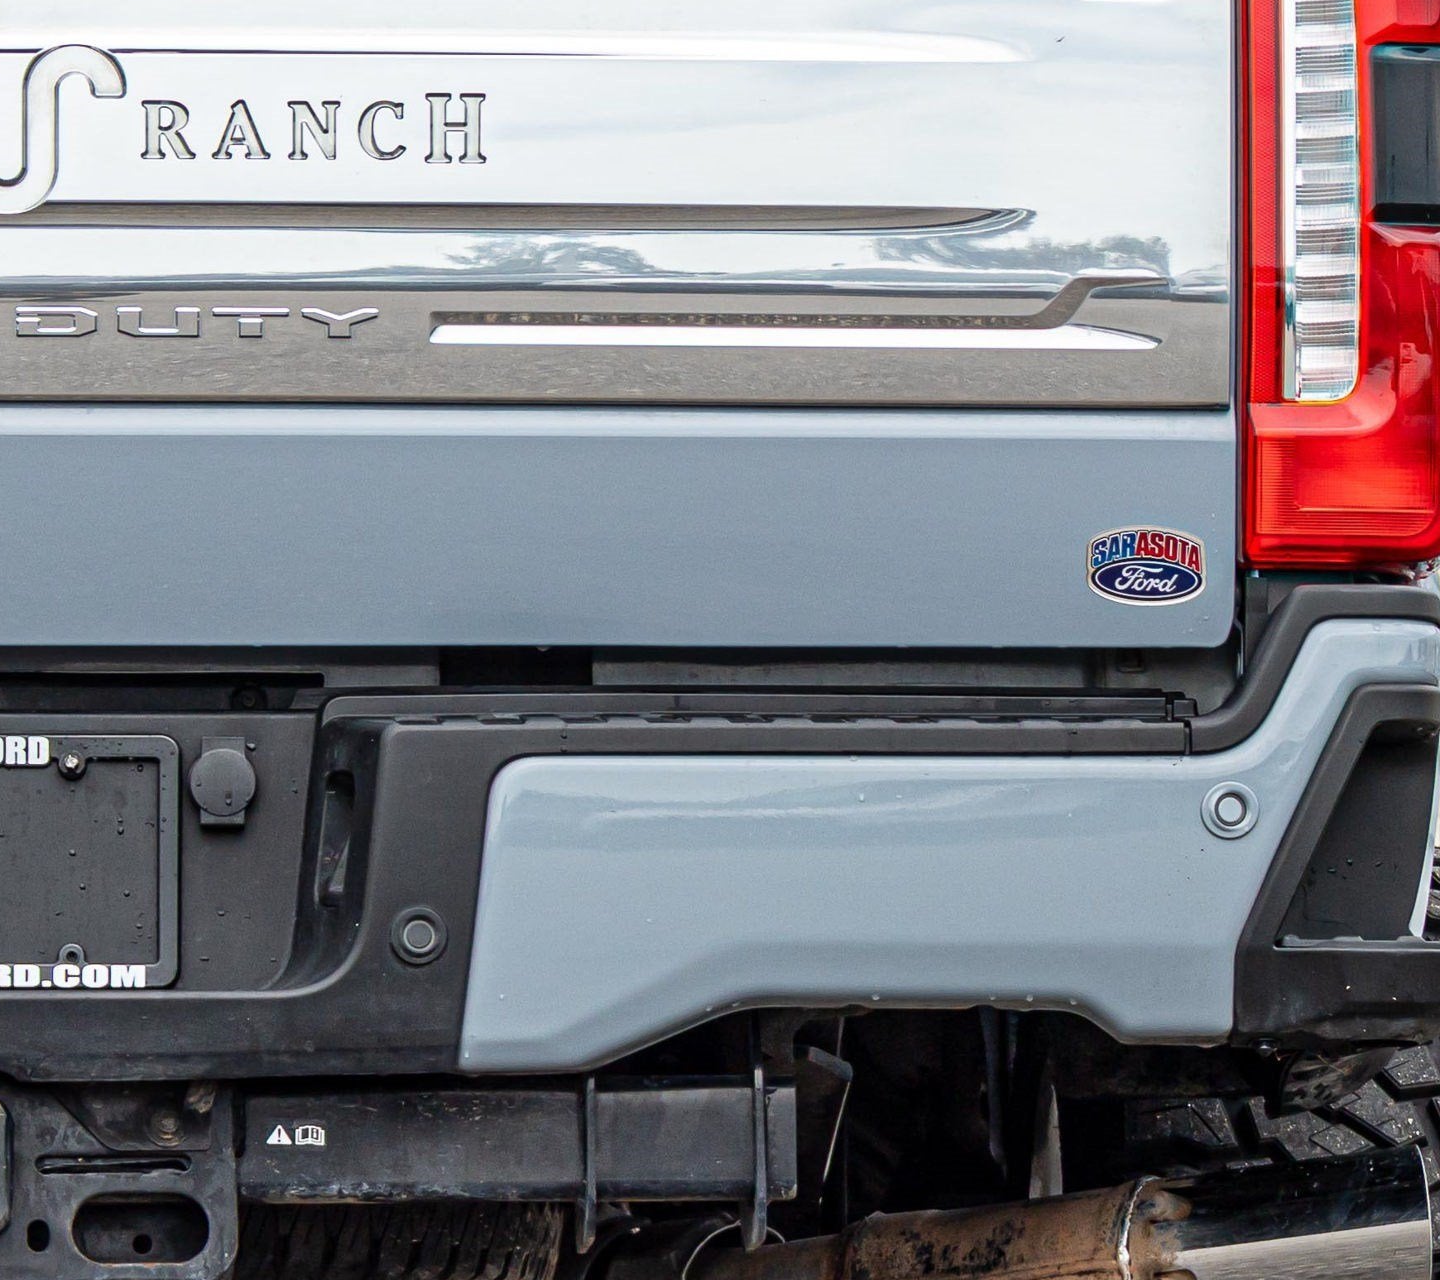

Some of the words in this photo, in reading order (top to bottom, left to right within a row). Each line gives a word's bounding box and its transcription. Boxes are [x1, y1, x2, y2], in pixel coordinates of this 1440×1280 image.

[140, 93, 486, 164] RANCH
[15, 305, 379, 338] DUTY
[1090, 529, 1203, 574] SARASOTA
[1115, 564, 1179, 593] Ford
